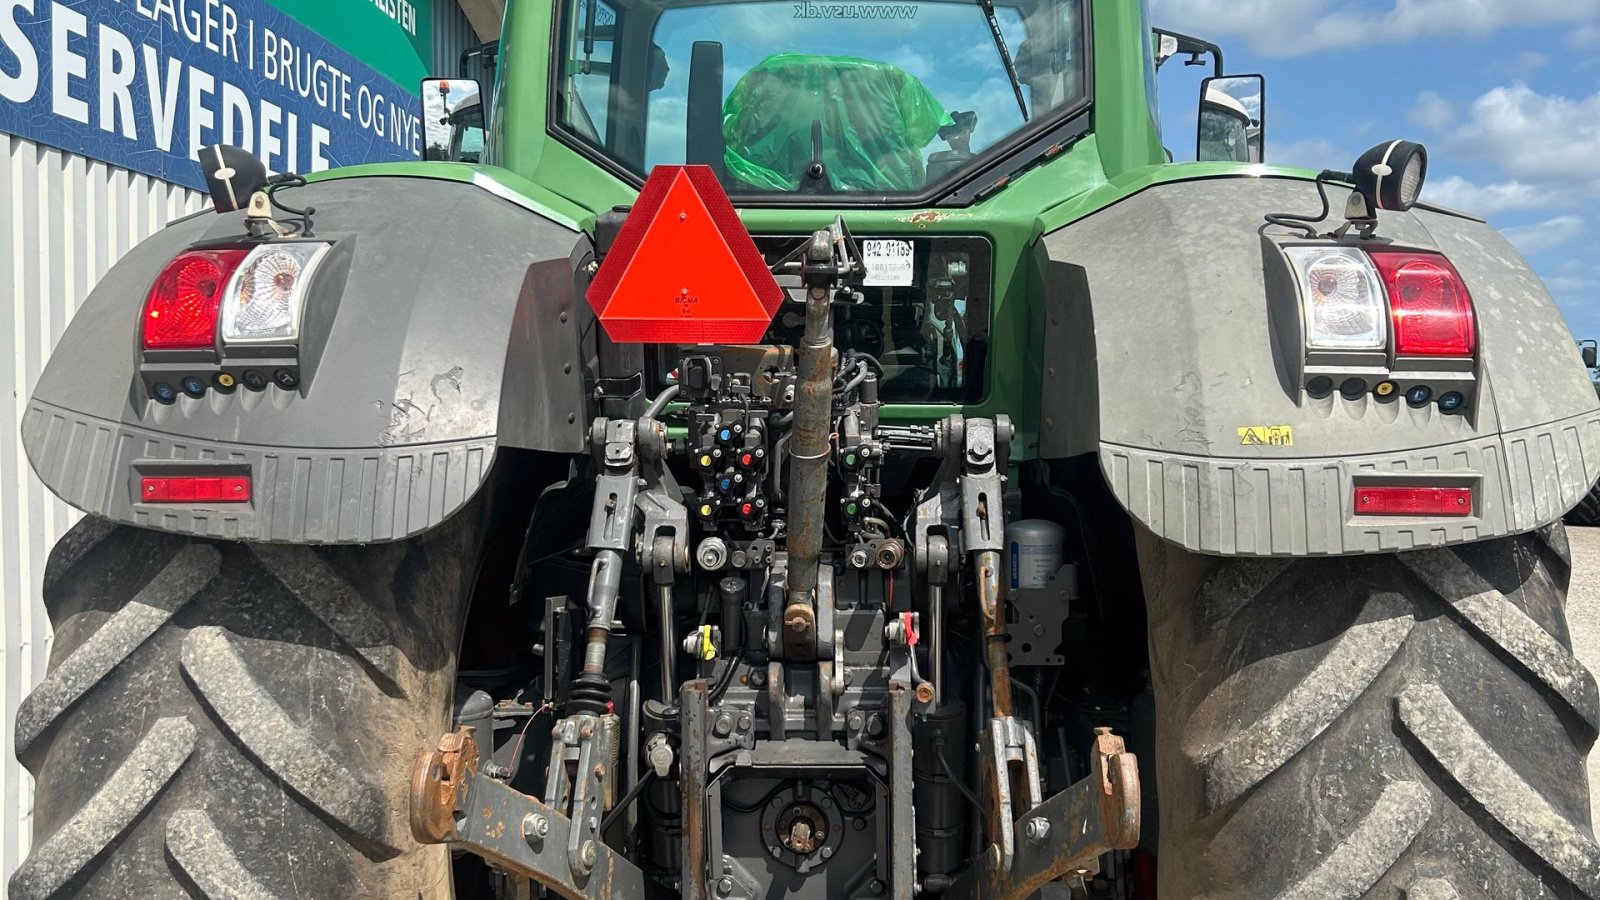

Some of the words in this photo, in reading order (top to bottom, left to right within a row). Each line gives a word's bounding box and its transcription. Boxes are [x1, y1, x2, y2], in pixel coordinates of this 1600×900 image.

[136, 0, 239, 63] AGER
[249, 19, 254, 70] I
[264, 27, 352, 120] BRUGTE
[358, 85, 385, 137] OG
[390, 102, 421, 157] NYE
